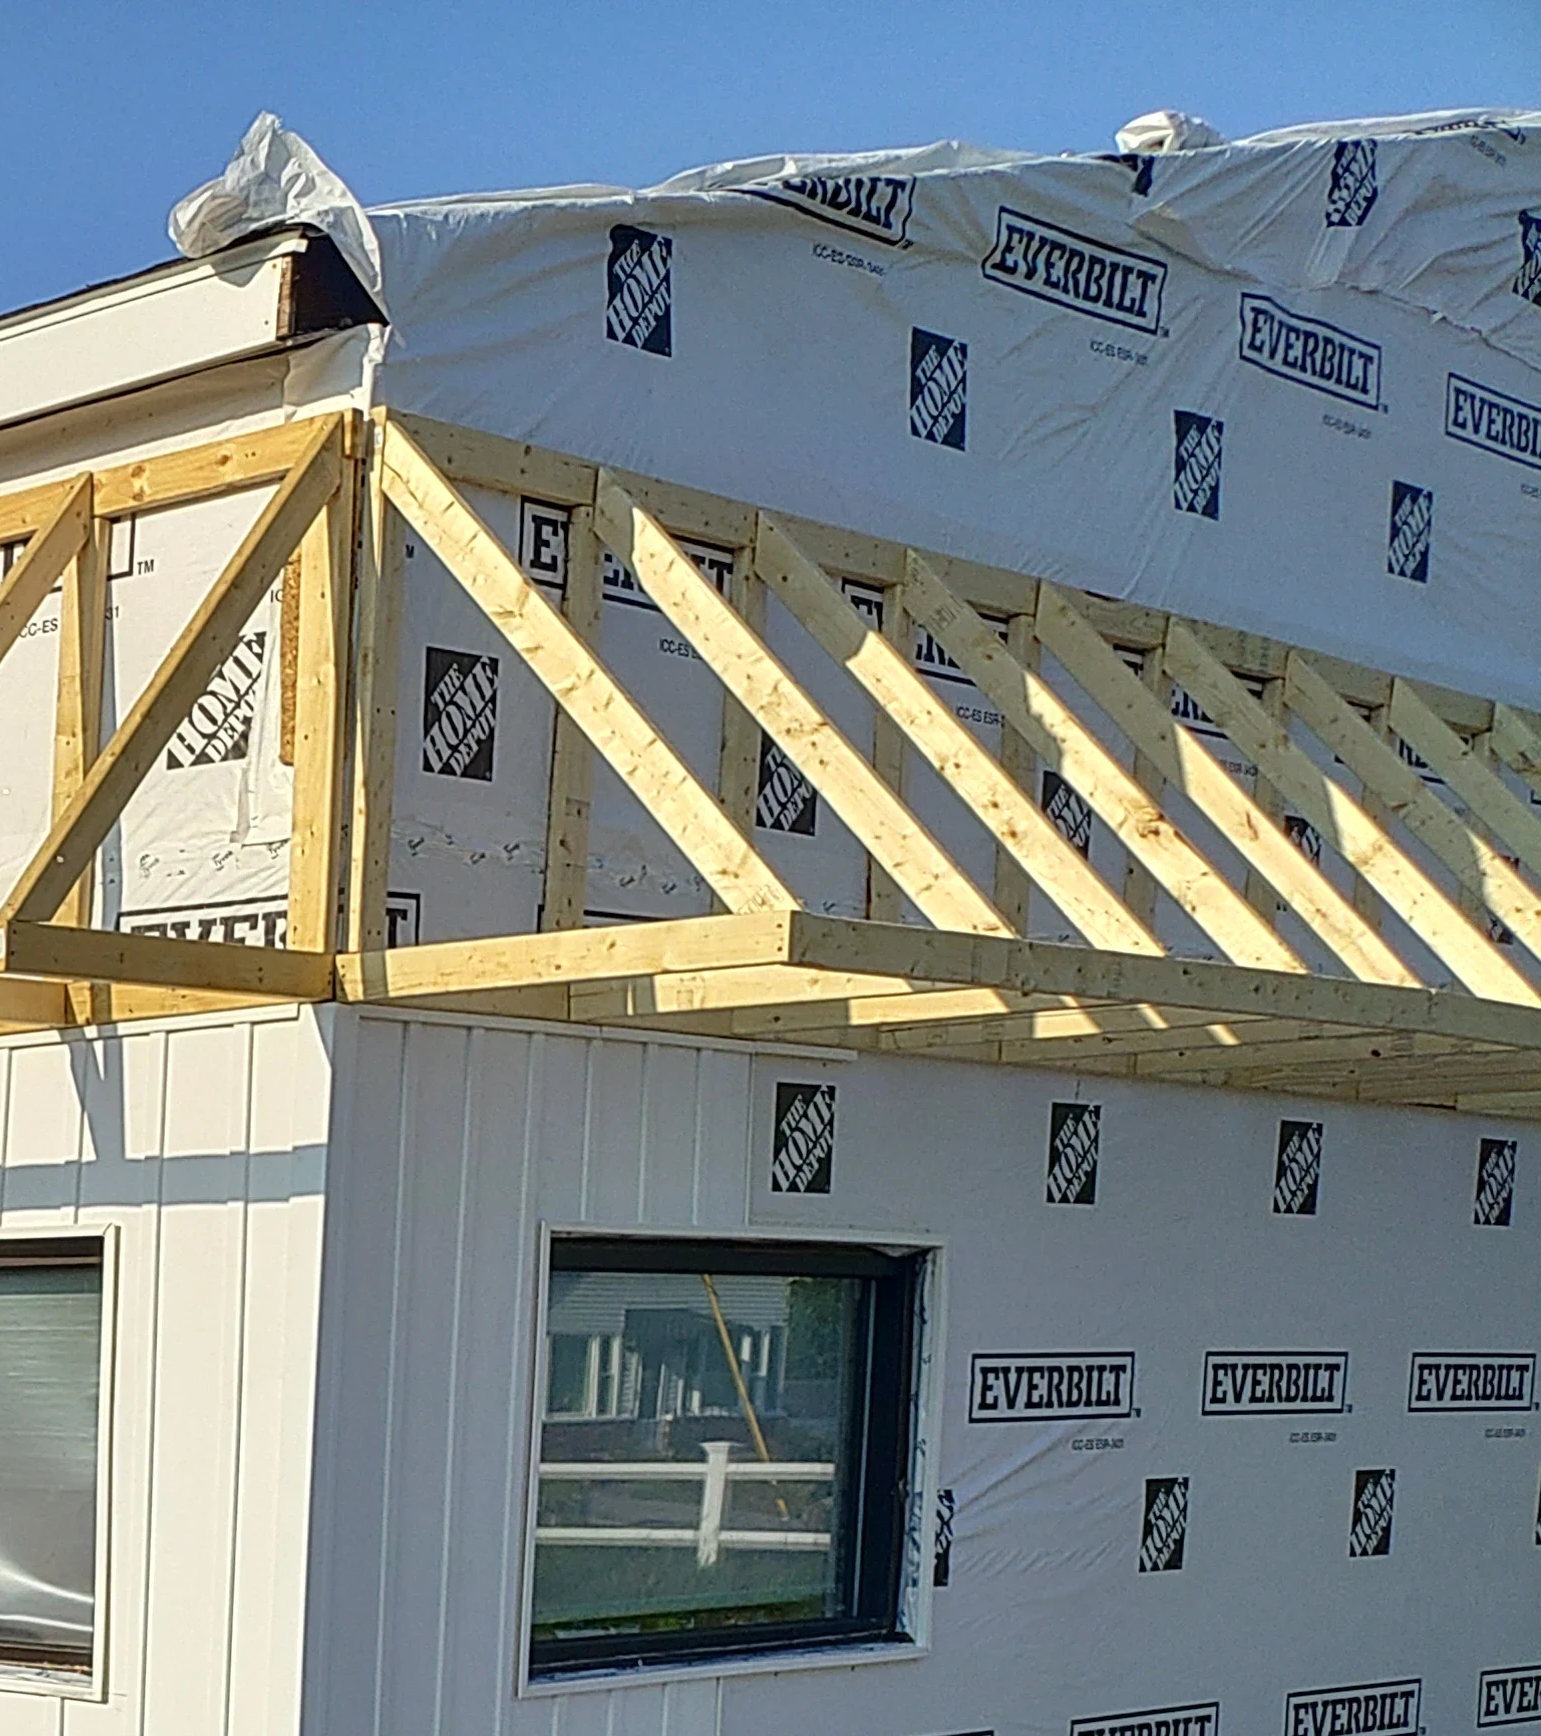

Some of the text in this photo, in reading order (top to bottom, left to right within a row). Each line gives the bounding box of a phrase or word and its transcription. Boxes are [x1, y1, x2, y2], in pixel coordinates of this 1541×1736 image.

[606, 236, 671, 341] HOME
[613, 239, 642, 281] THE
[990, 223, 1158, 318] EVERBILT
[632, 281, 671, 348] DEPOT
[1248, 306, 1375, 396] EVERBILT
[911, 341, 968, 437] HOME
[137, 559, 155, 576] TM
[19, 617, 59, 638] CC-ES
[423, 657, 497, 773] HOME
[432, 663, 463, 712] THE
[448, 702, 495, 776] DEPOT
[772, 1085, 835, 1191] HOME
[780, 1093, 806, 1138] THE
[793, 1124, 833, 1192] DEPOT
[1047, 1105, 1100, 1202] HOME
[977, 1364, 1127, 1410] EVERBILT
[1209, 1363, 1341, 1404] EVERBILT
[1415, 1363, 1530, 1401] EVERBILT
